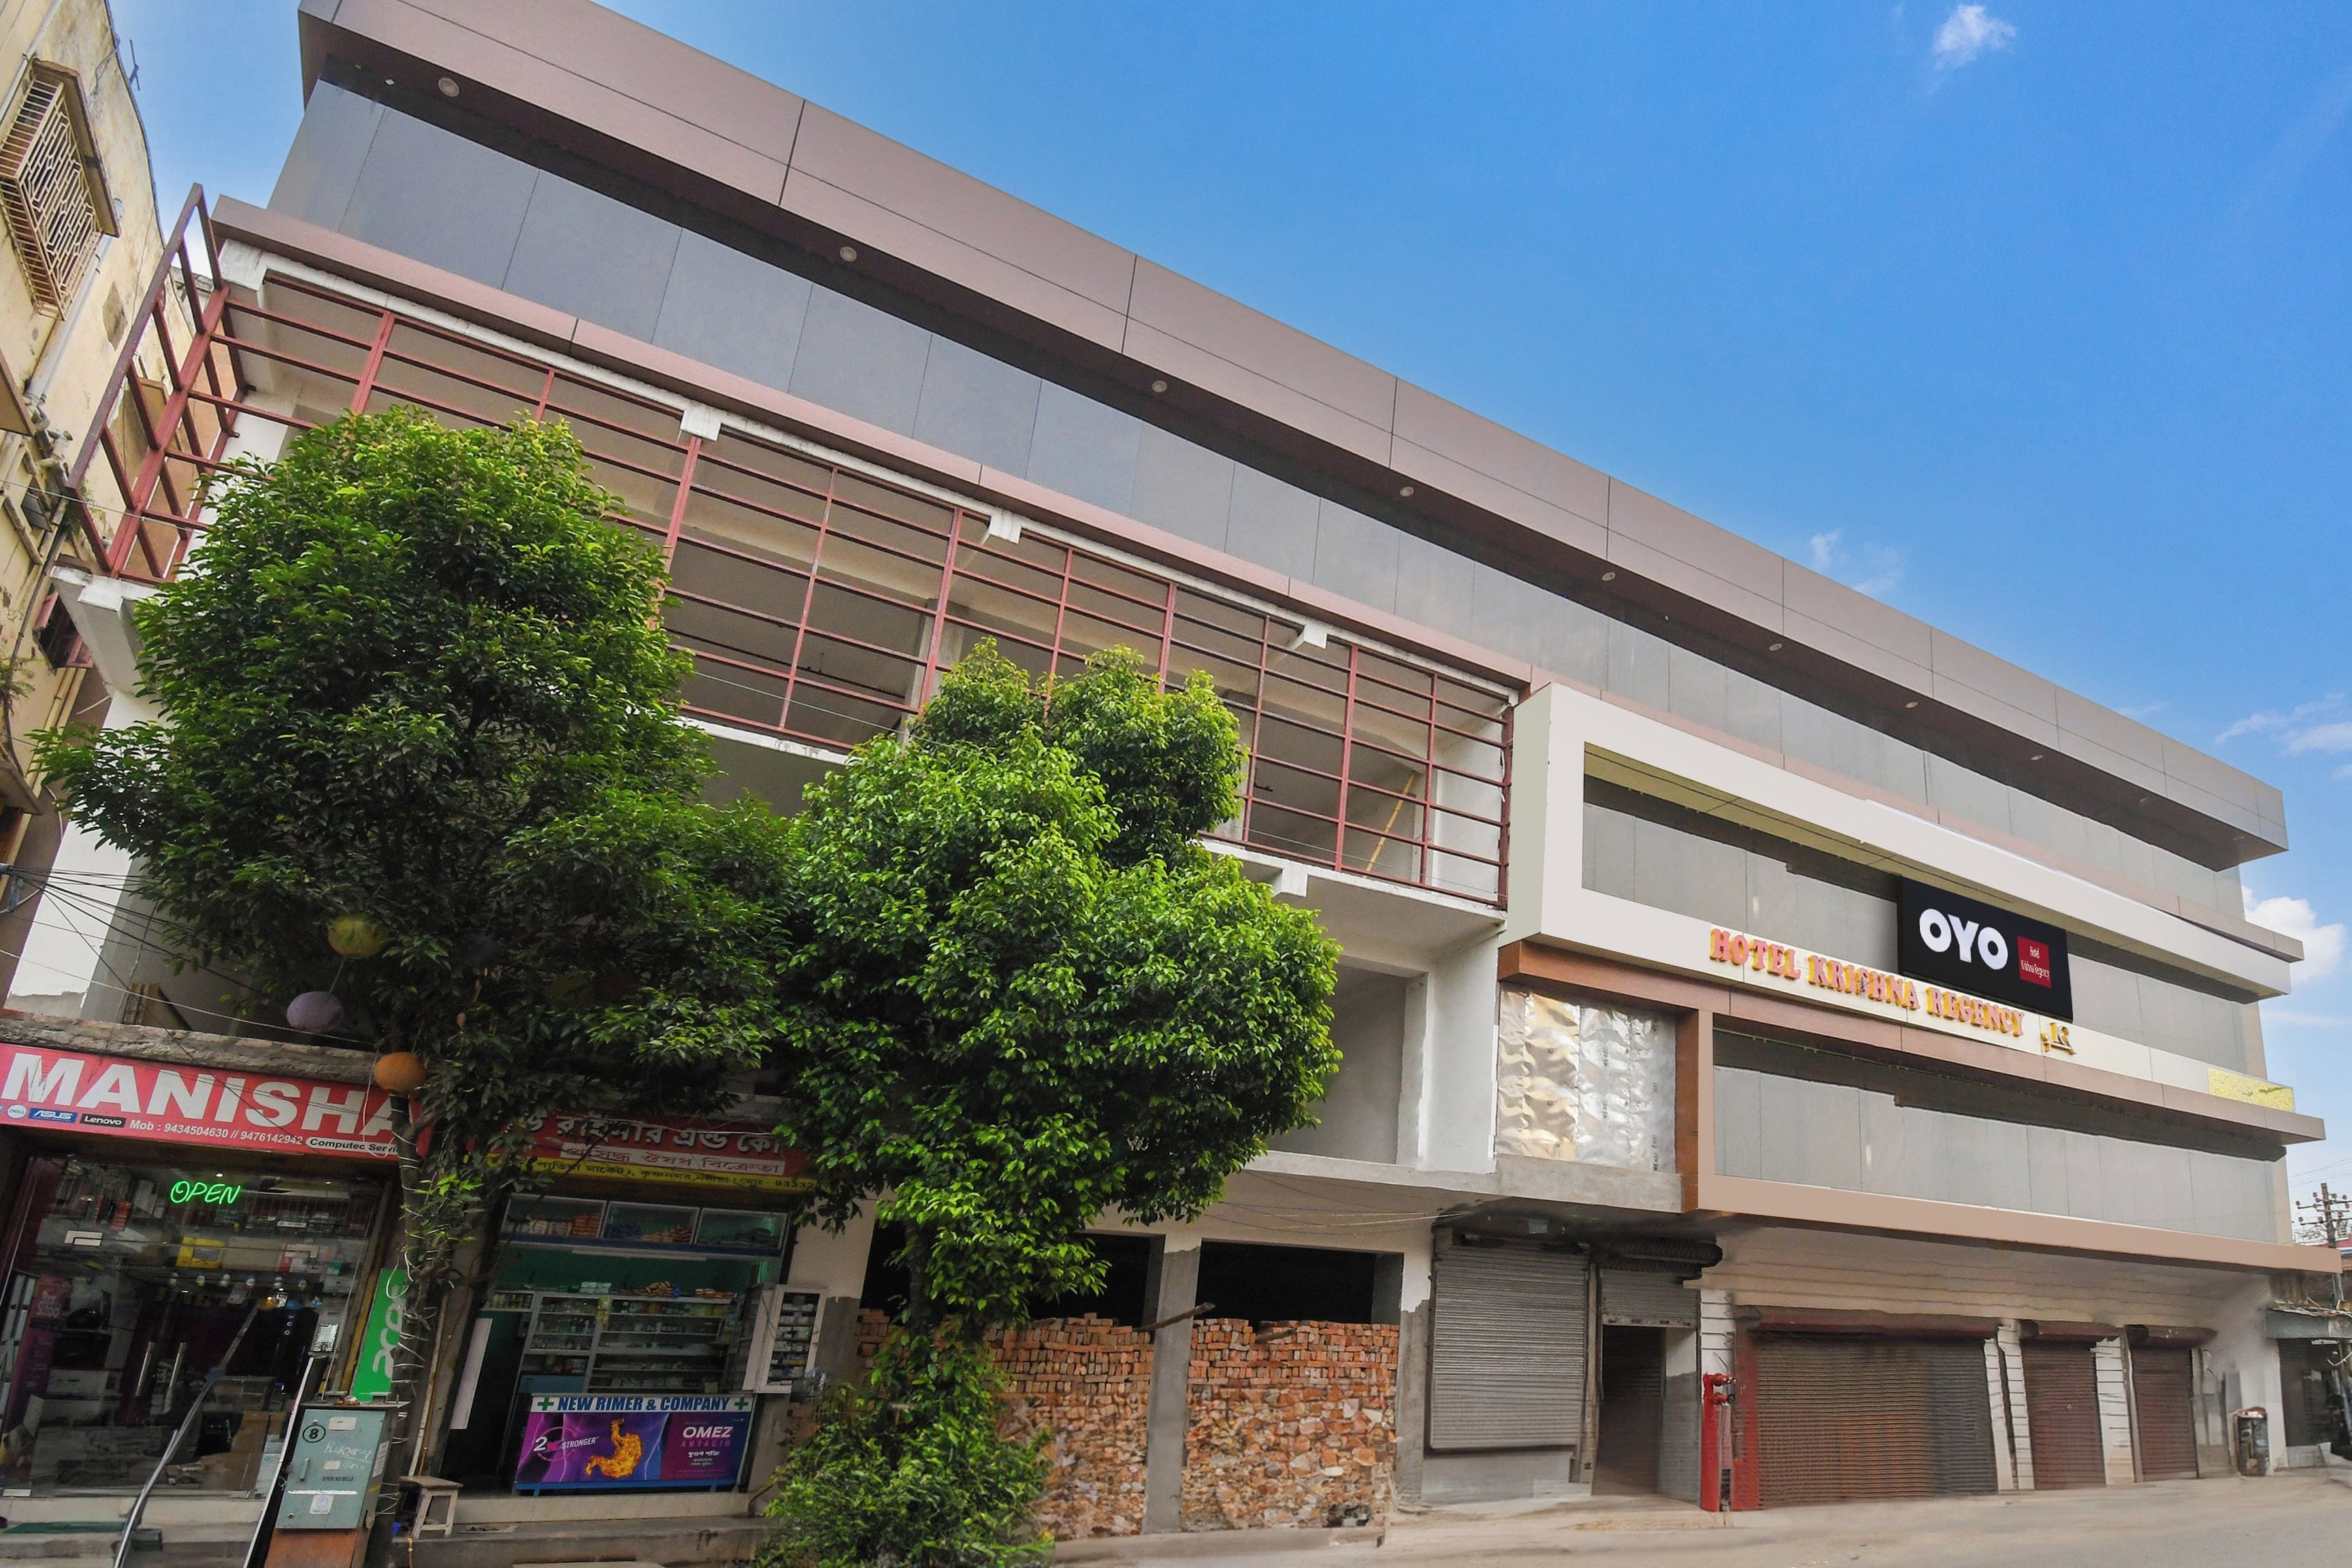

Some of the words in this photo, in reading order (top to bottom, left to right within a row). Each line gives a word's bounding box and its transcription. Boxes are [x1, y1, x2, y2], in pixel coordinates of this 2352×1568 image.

[1919, 908, 2008, 970] OYO
[2029, 946, 2040, 958] Hotel
[2021, 960, 2034, 974] Krishna
[2034, 964, 2050, 981] Regency
[1710, 928, 1801, 980] HOTEL
[1808, 956, 1921, 1011] KRISHNA
[1926, 987, 2024, 1036] REGENCY
[33, 1110, 73, 1120] ASUS
[84, 1115, 122, 1126] Lenovo
[129, 1120, 154, 1131] Mob
[164, 1123, 229, 1139] 9434504630
[310, 1138, 365, 1150] Computec
[368, 1143, 398, 1152] Servi
[169, 1179, 242, 1205] OPEN
[557, 1397, 593, 1411] NEW
[595, 1397, 642, 1411] RIMER
[646, 1399, 656, 1411] &
[660, 1396, 730, 1411] COMPANY
[308, 1428, 319, 1439] 8
[683, 1426, 733, 1438] OMEZ
